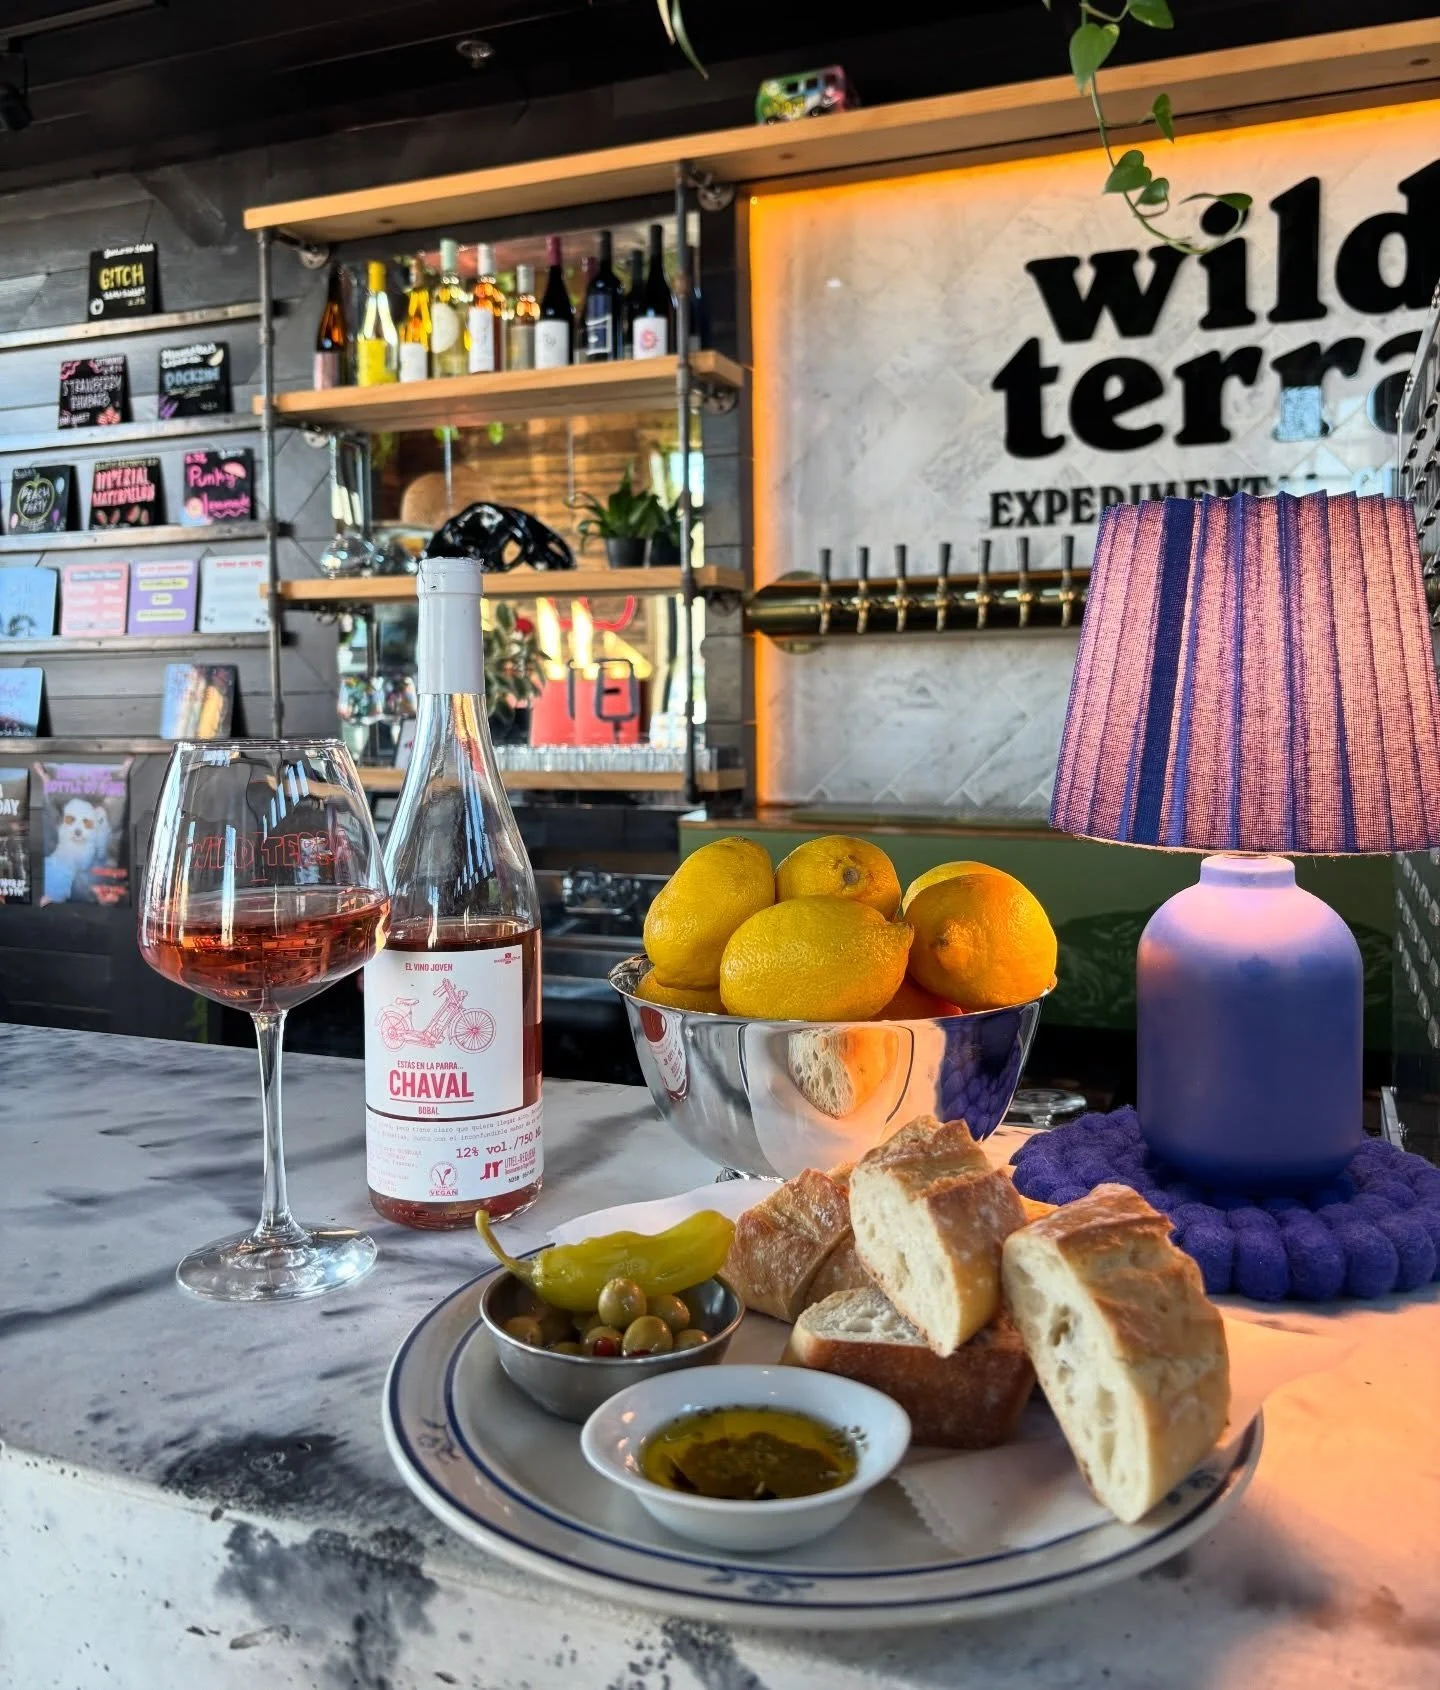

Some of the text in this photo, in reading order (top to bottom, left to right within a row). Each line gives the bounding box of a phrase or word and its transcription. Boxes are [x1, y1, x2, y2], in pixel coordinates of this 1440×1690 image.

[1026, 158, 1440, 343] wild
[991, 330, 1424, 459] terra
[405, 962, 453, 972] EL VINO JOVEN
[416, 1061, 423, 1070] EN
[426, 1061, 434, 1070] LA
[389, 1069, 474, 1098] CHAVAL
[418, 1106, 439, 1115] BOBAL
[456, 1146, 479, 1159] 12%
[429, 1188, 459, 1197] VEGAN
